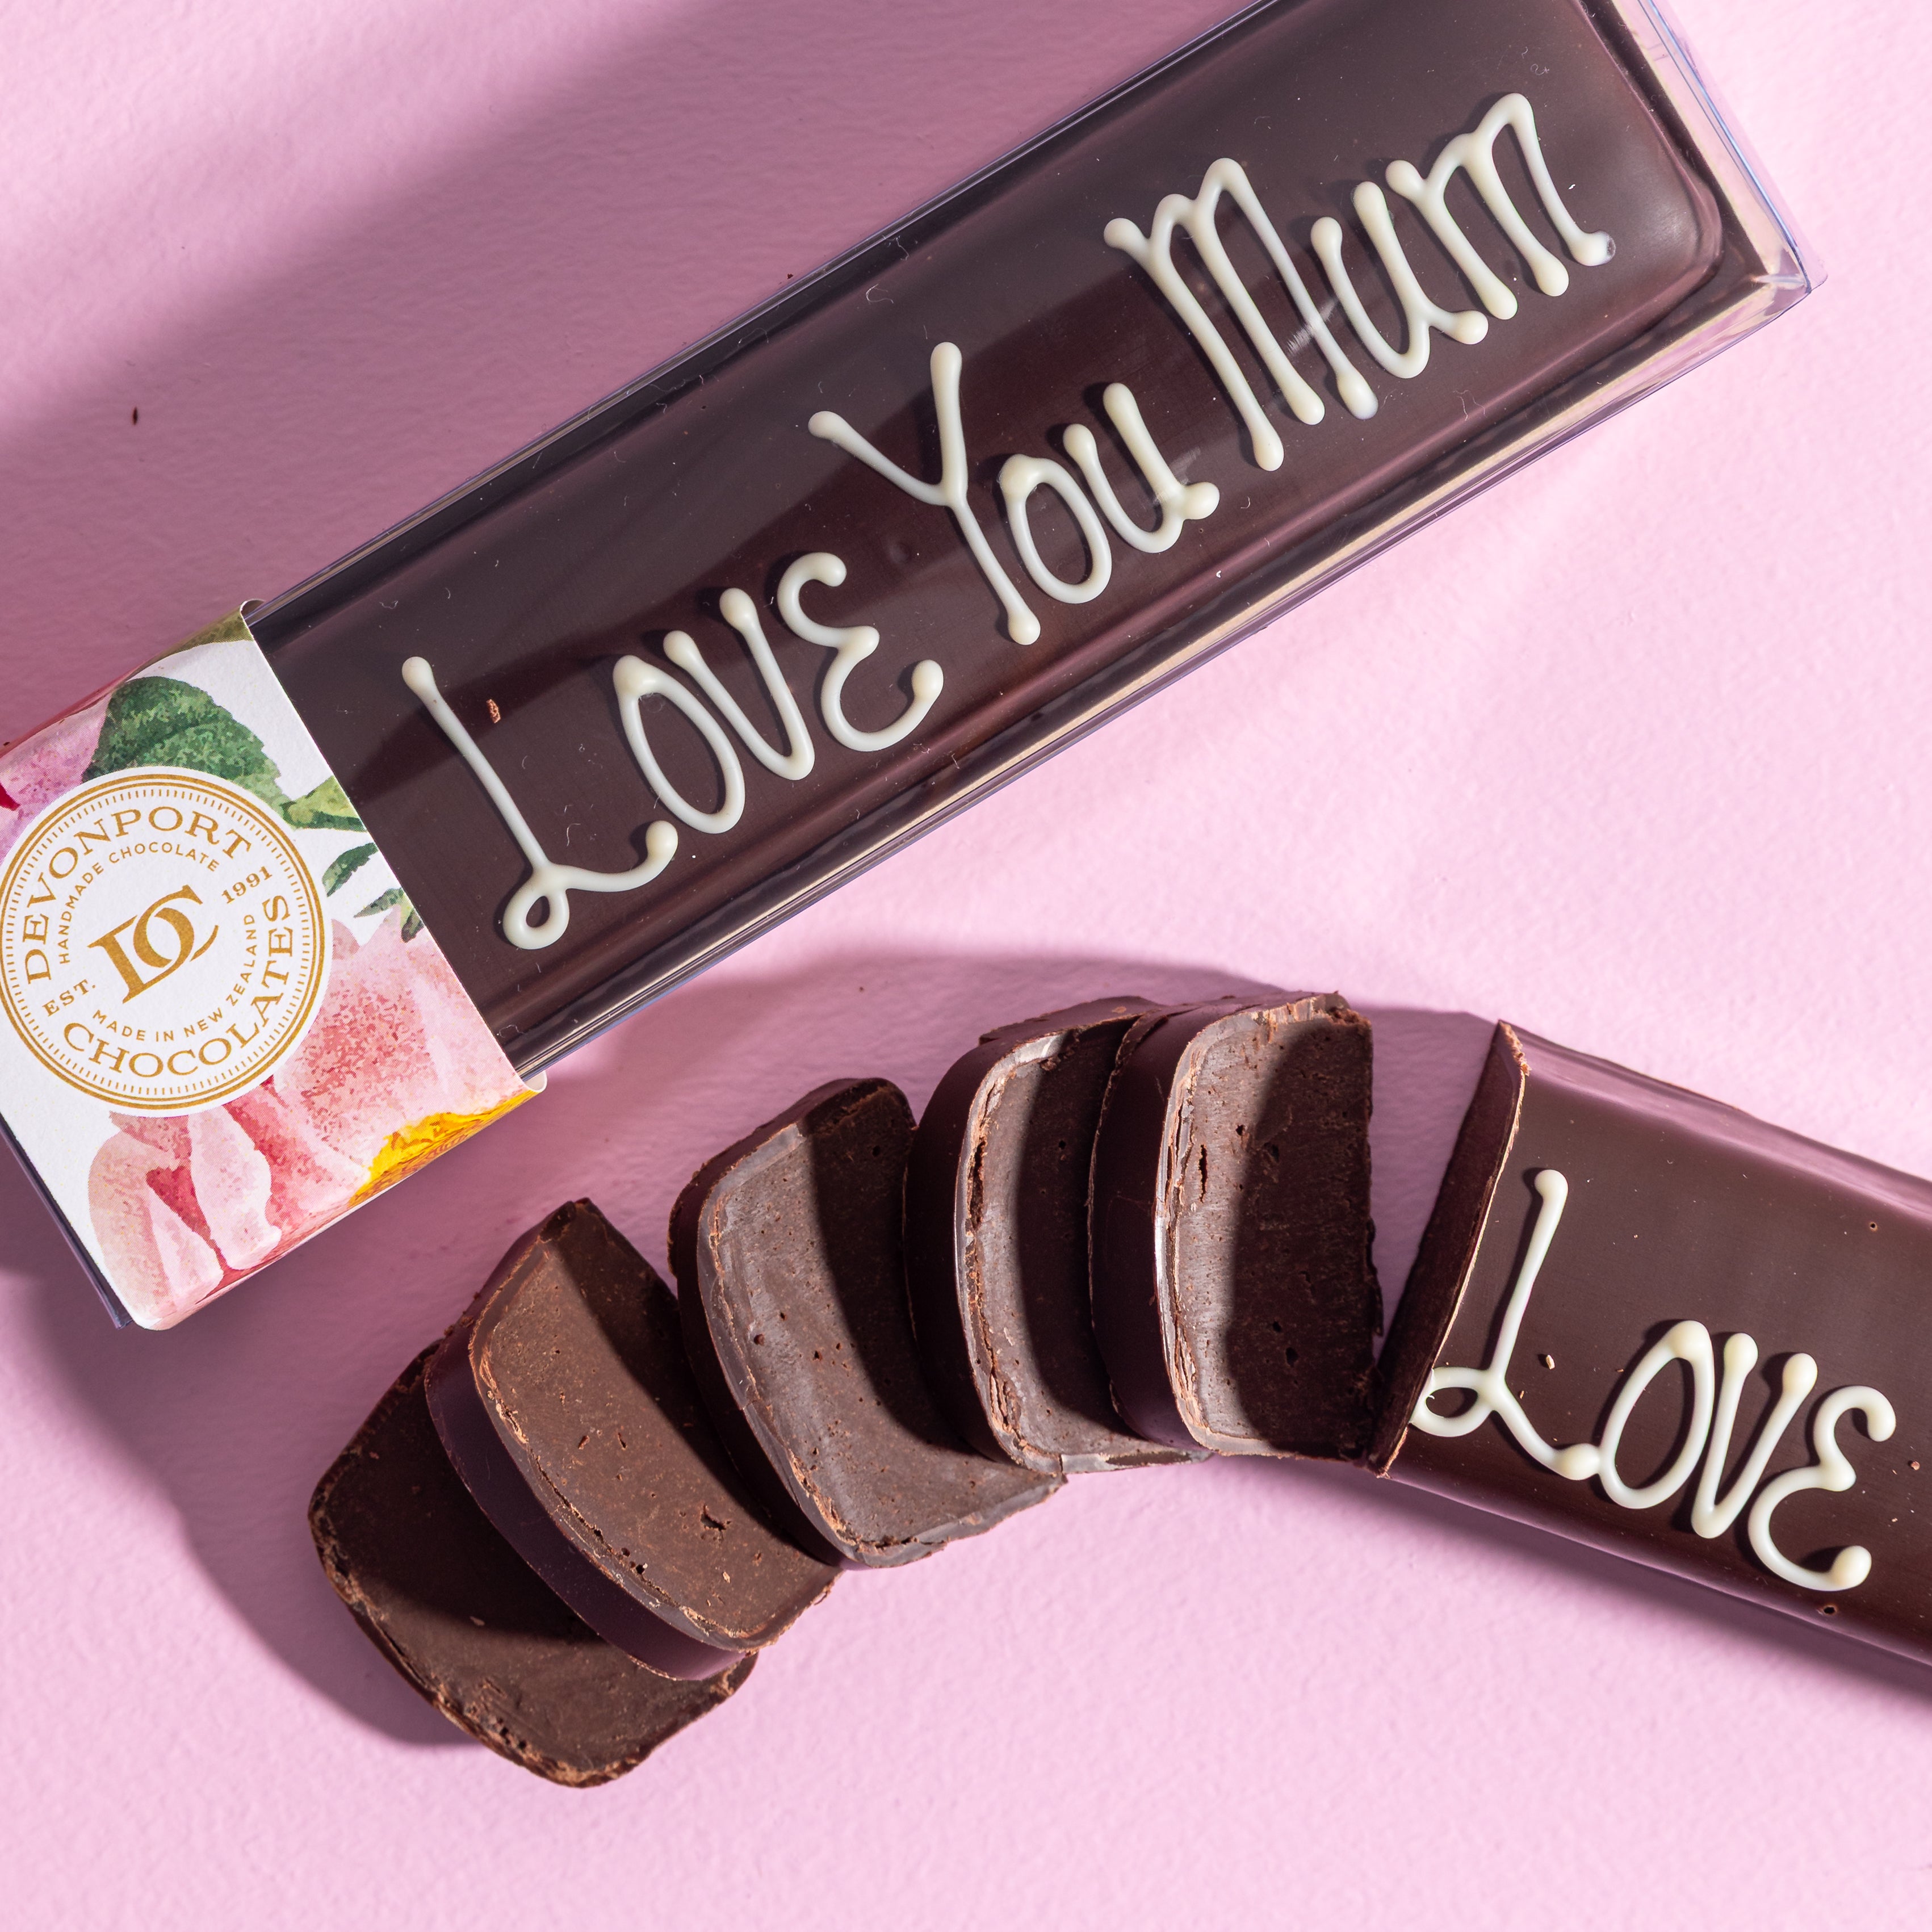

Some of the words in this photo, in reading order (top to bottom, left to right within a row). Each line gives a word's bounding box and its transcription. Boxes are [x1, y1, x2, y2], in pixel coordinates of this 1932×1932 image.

[22, 806, 251, 984] DEVONPORT
[57, 862, 104, 964] HANDMADE
[108, 841, 220, 873] CHOCOLATE
[221, 865, 273, 905] 1991
[41, 983, 97, 1017] EST.
[62, 894, 294, 1078] CHOCOLATES
[93, 1009, 146, 1041] MADE
[155, 1030, 174, 1042] IN
[183, 1008, 224, 1036] NEW
[226, 913, 258, 1007] ZEALAND
